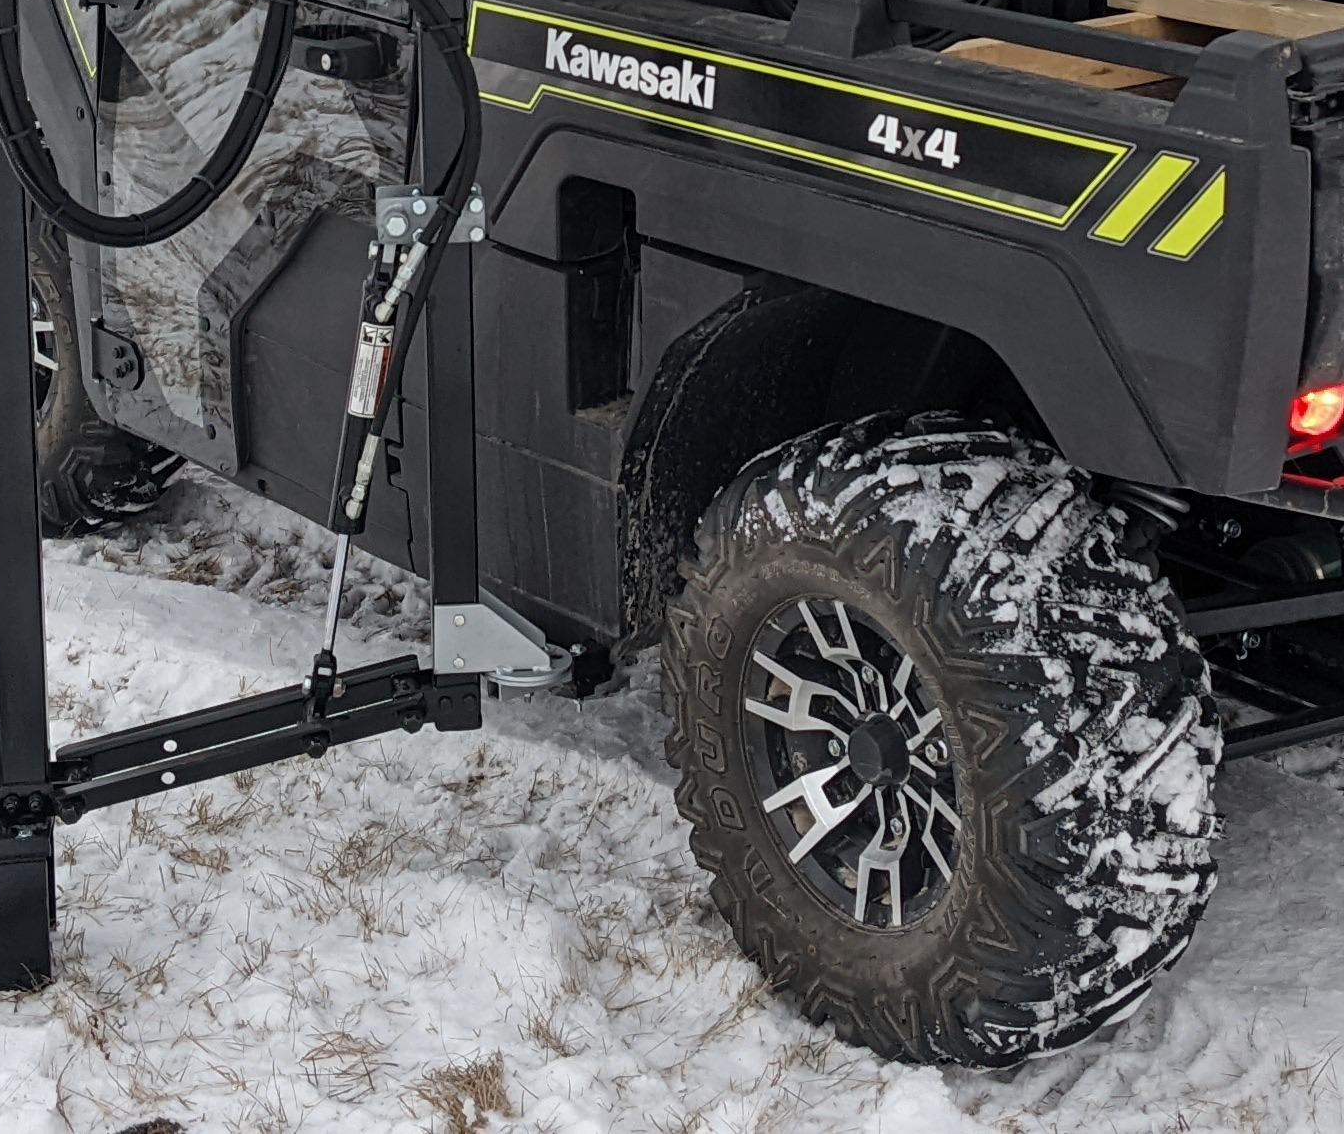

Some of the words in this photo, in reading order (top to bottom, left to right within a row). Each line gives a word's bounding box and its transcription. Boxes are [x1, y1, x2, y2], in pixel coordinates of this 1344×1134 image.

[545, 27, 716, 110] Kawasaki
[868, 113, 961, 169] 4x4
[696, 615, 747, 831] DURO
